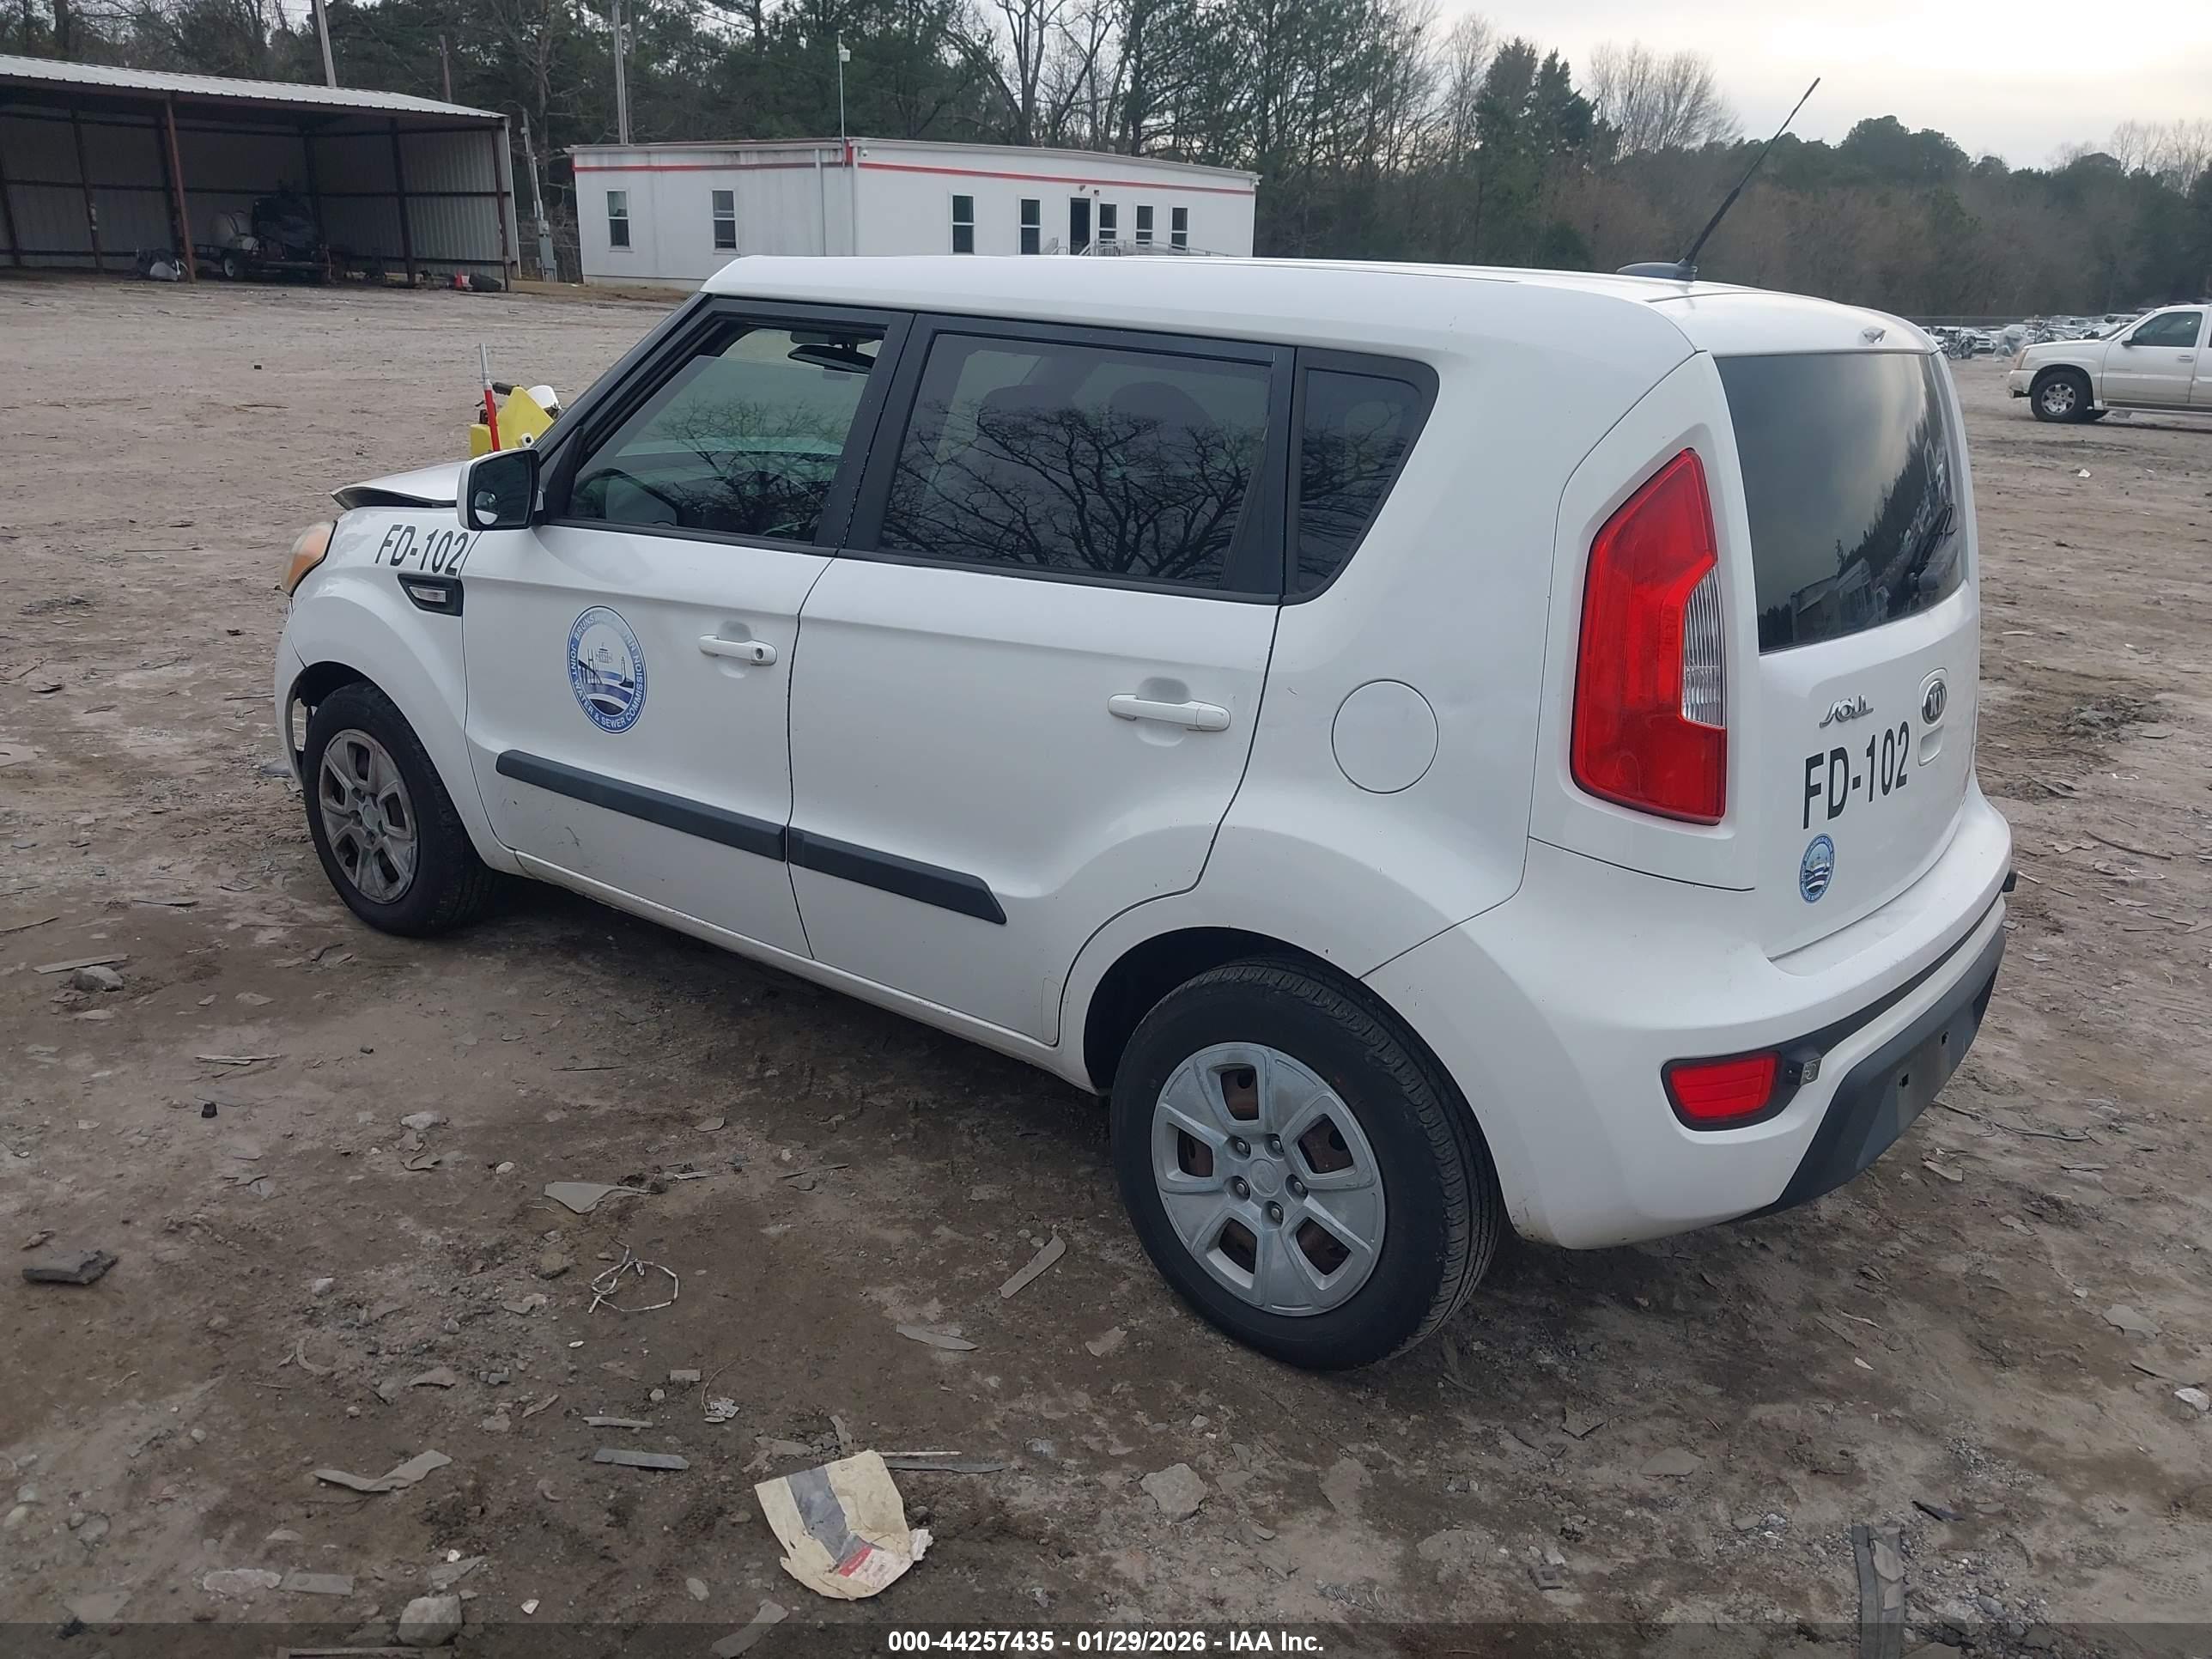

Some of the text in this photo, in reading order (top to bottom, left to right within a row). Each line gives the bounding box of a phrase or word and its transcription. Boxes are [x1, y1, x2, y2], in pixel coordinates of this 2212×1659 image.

[375, 524, 469, 576] FD-102
[574, 679, 594, 714] WATER
[601, 716, 626, 728] SEWER
[625, 654, 643, 721] COMMISSION
[1803, 721, 1910, 830] FD-102
